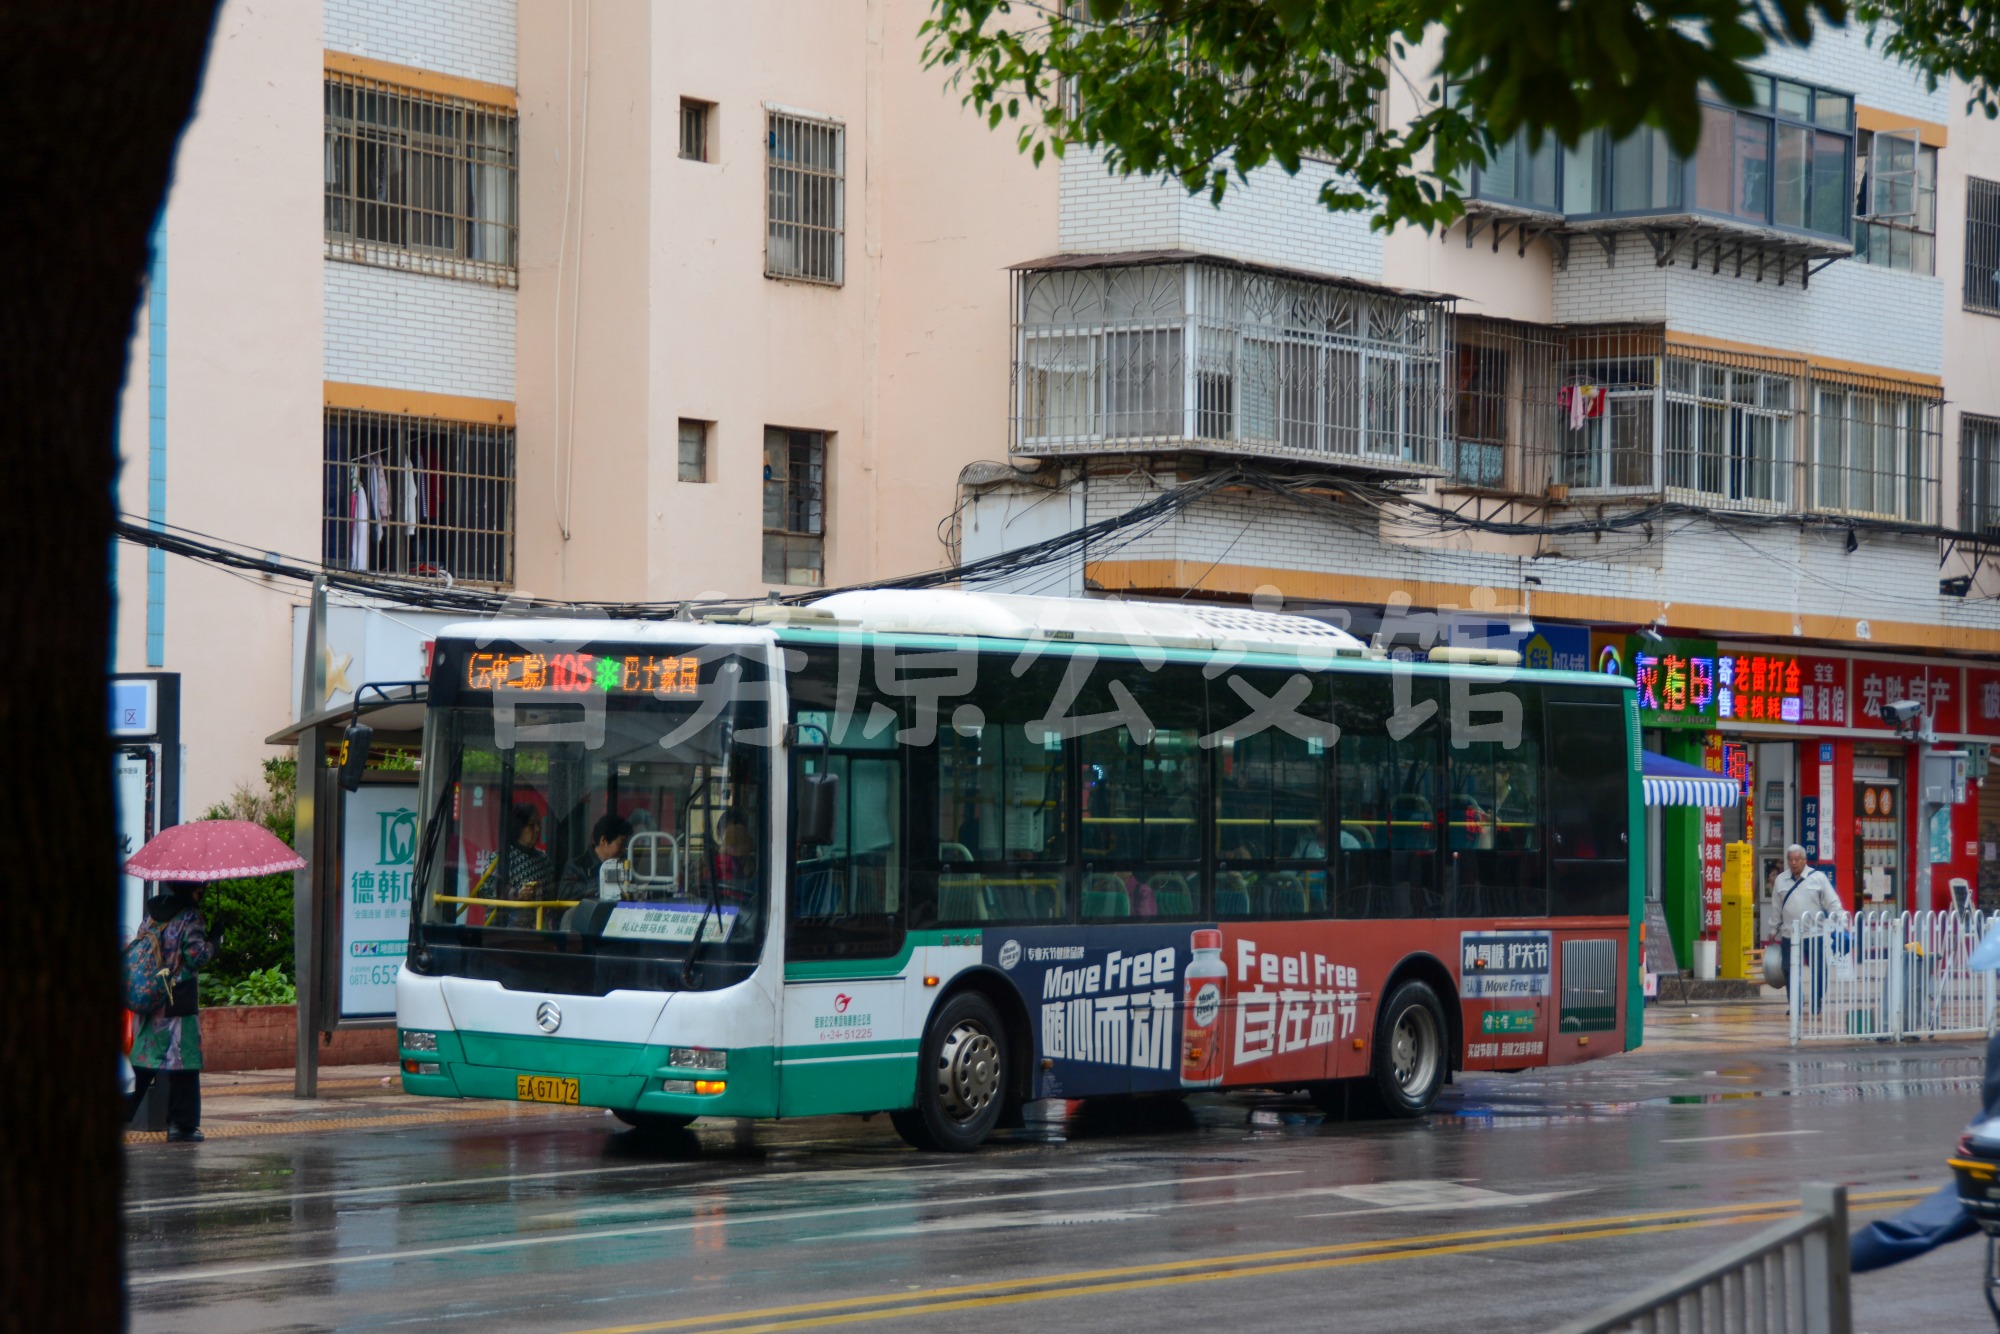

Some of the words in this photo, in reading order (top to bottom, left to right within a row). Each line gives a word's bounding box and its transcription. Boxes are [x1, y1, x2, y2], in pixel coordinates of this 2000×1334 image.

[551, 653, 592, 691] 105
[622, 656, 698, 693] 巴士家园
[1735, 656, 1800, 693] 老雷打金
[1814, 663, 1833, 682] 宝宝
[1718, 656, 1733, 717] 寄售
[1734, 695, 1780, 718] 零损耗
[1802, 685, 1844, 721] 照相馆
[1706, 756, 1722, 772] 回收
[1806, 803, 1816, 855] 打印复印
[1706, 844, 1721, 860] 名表
[1706, 866, 1721, 882] 名包
[1706, 888, 1721, 903] 名烟
[621, 921, 713, 937] 礼让斑马线，从我起
[644, 911, 699, 924] 创建文明城市
[1706, 910, 1721, 926] 名酒
[1237, 939, 1308, 984] Feel
[1314, 954, 1357, 987] Free
[1464, 944, 1504, 969] 补氨糖
[1508, 943, 1547, 968] 护关节
[1043, 965, 1100, 999] Move
[1104, 947, 1175, 990] Free
[1466, 980, 1483, 992] 认准
[1484, 980, 1508, 992] Move
[1042, 989, 1174, 1070] 随心而动
[1233, 984, 1358, 1066] 自在益节
